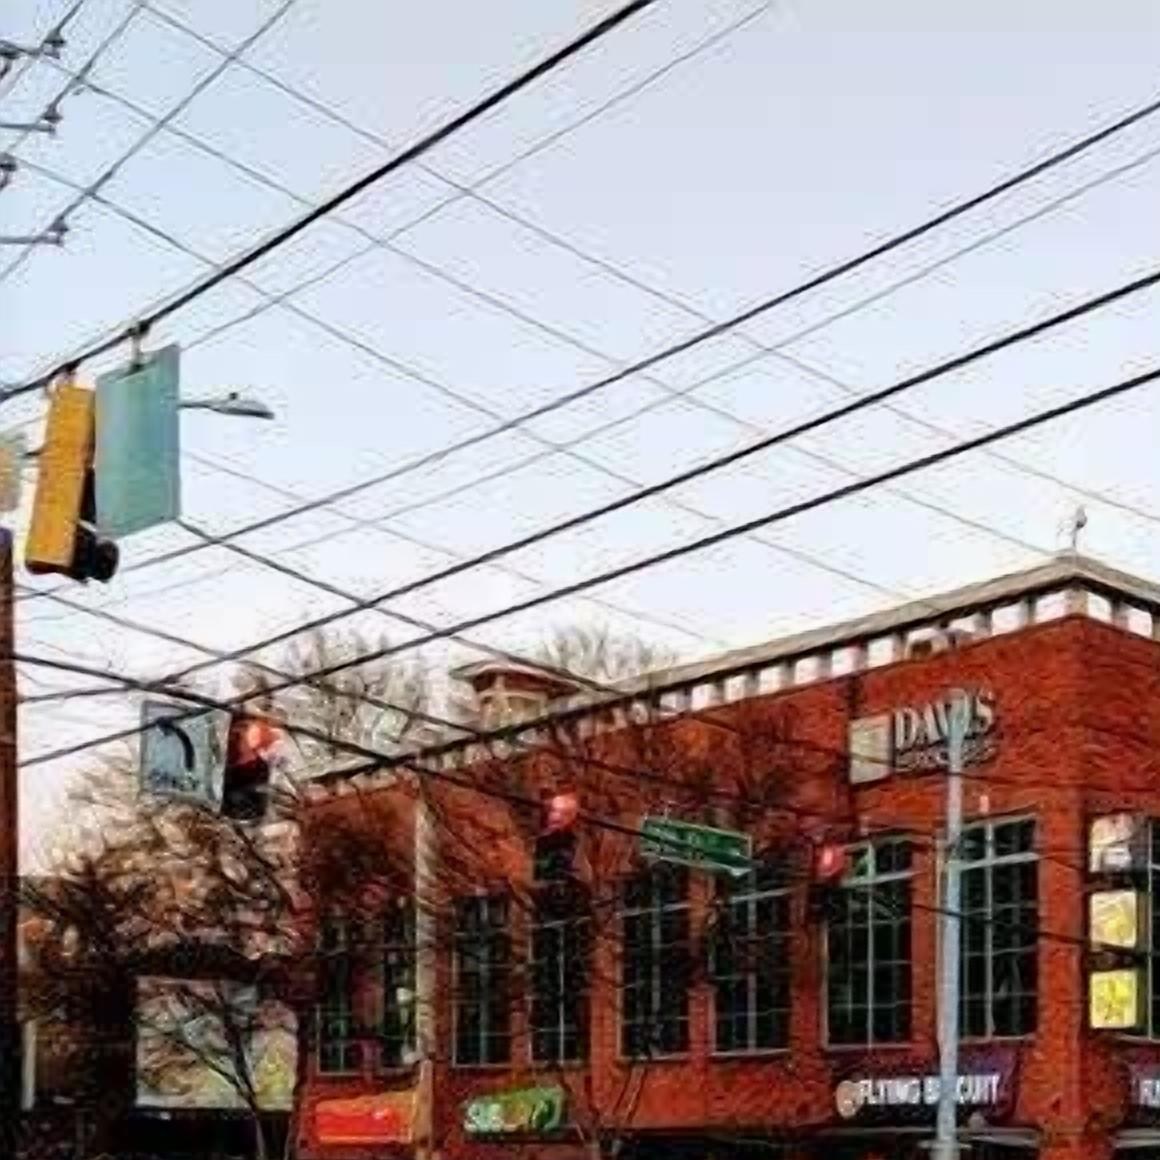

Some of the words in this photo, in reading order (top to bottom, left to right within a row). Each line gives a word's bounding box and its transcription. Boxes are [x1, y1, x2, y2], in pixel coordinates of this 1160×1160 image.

[894, 686, 994, 749] DAVIS
[860, 1078, 920, 1105] FLYING
[924, 1074, 1000, 1104] BCUIT
